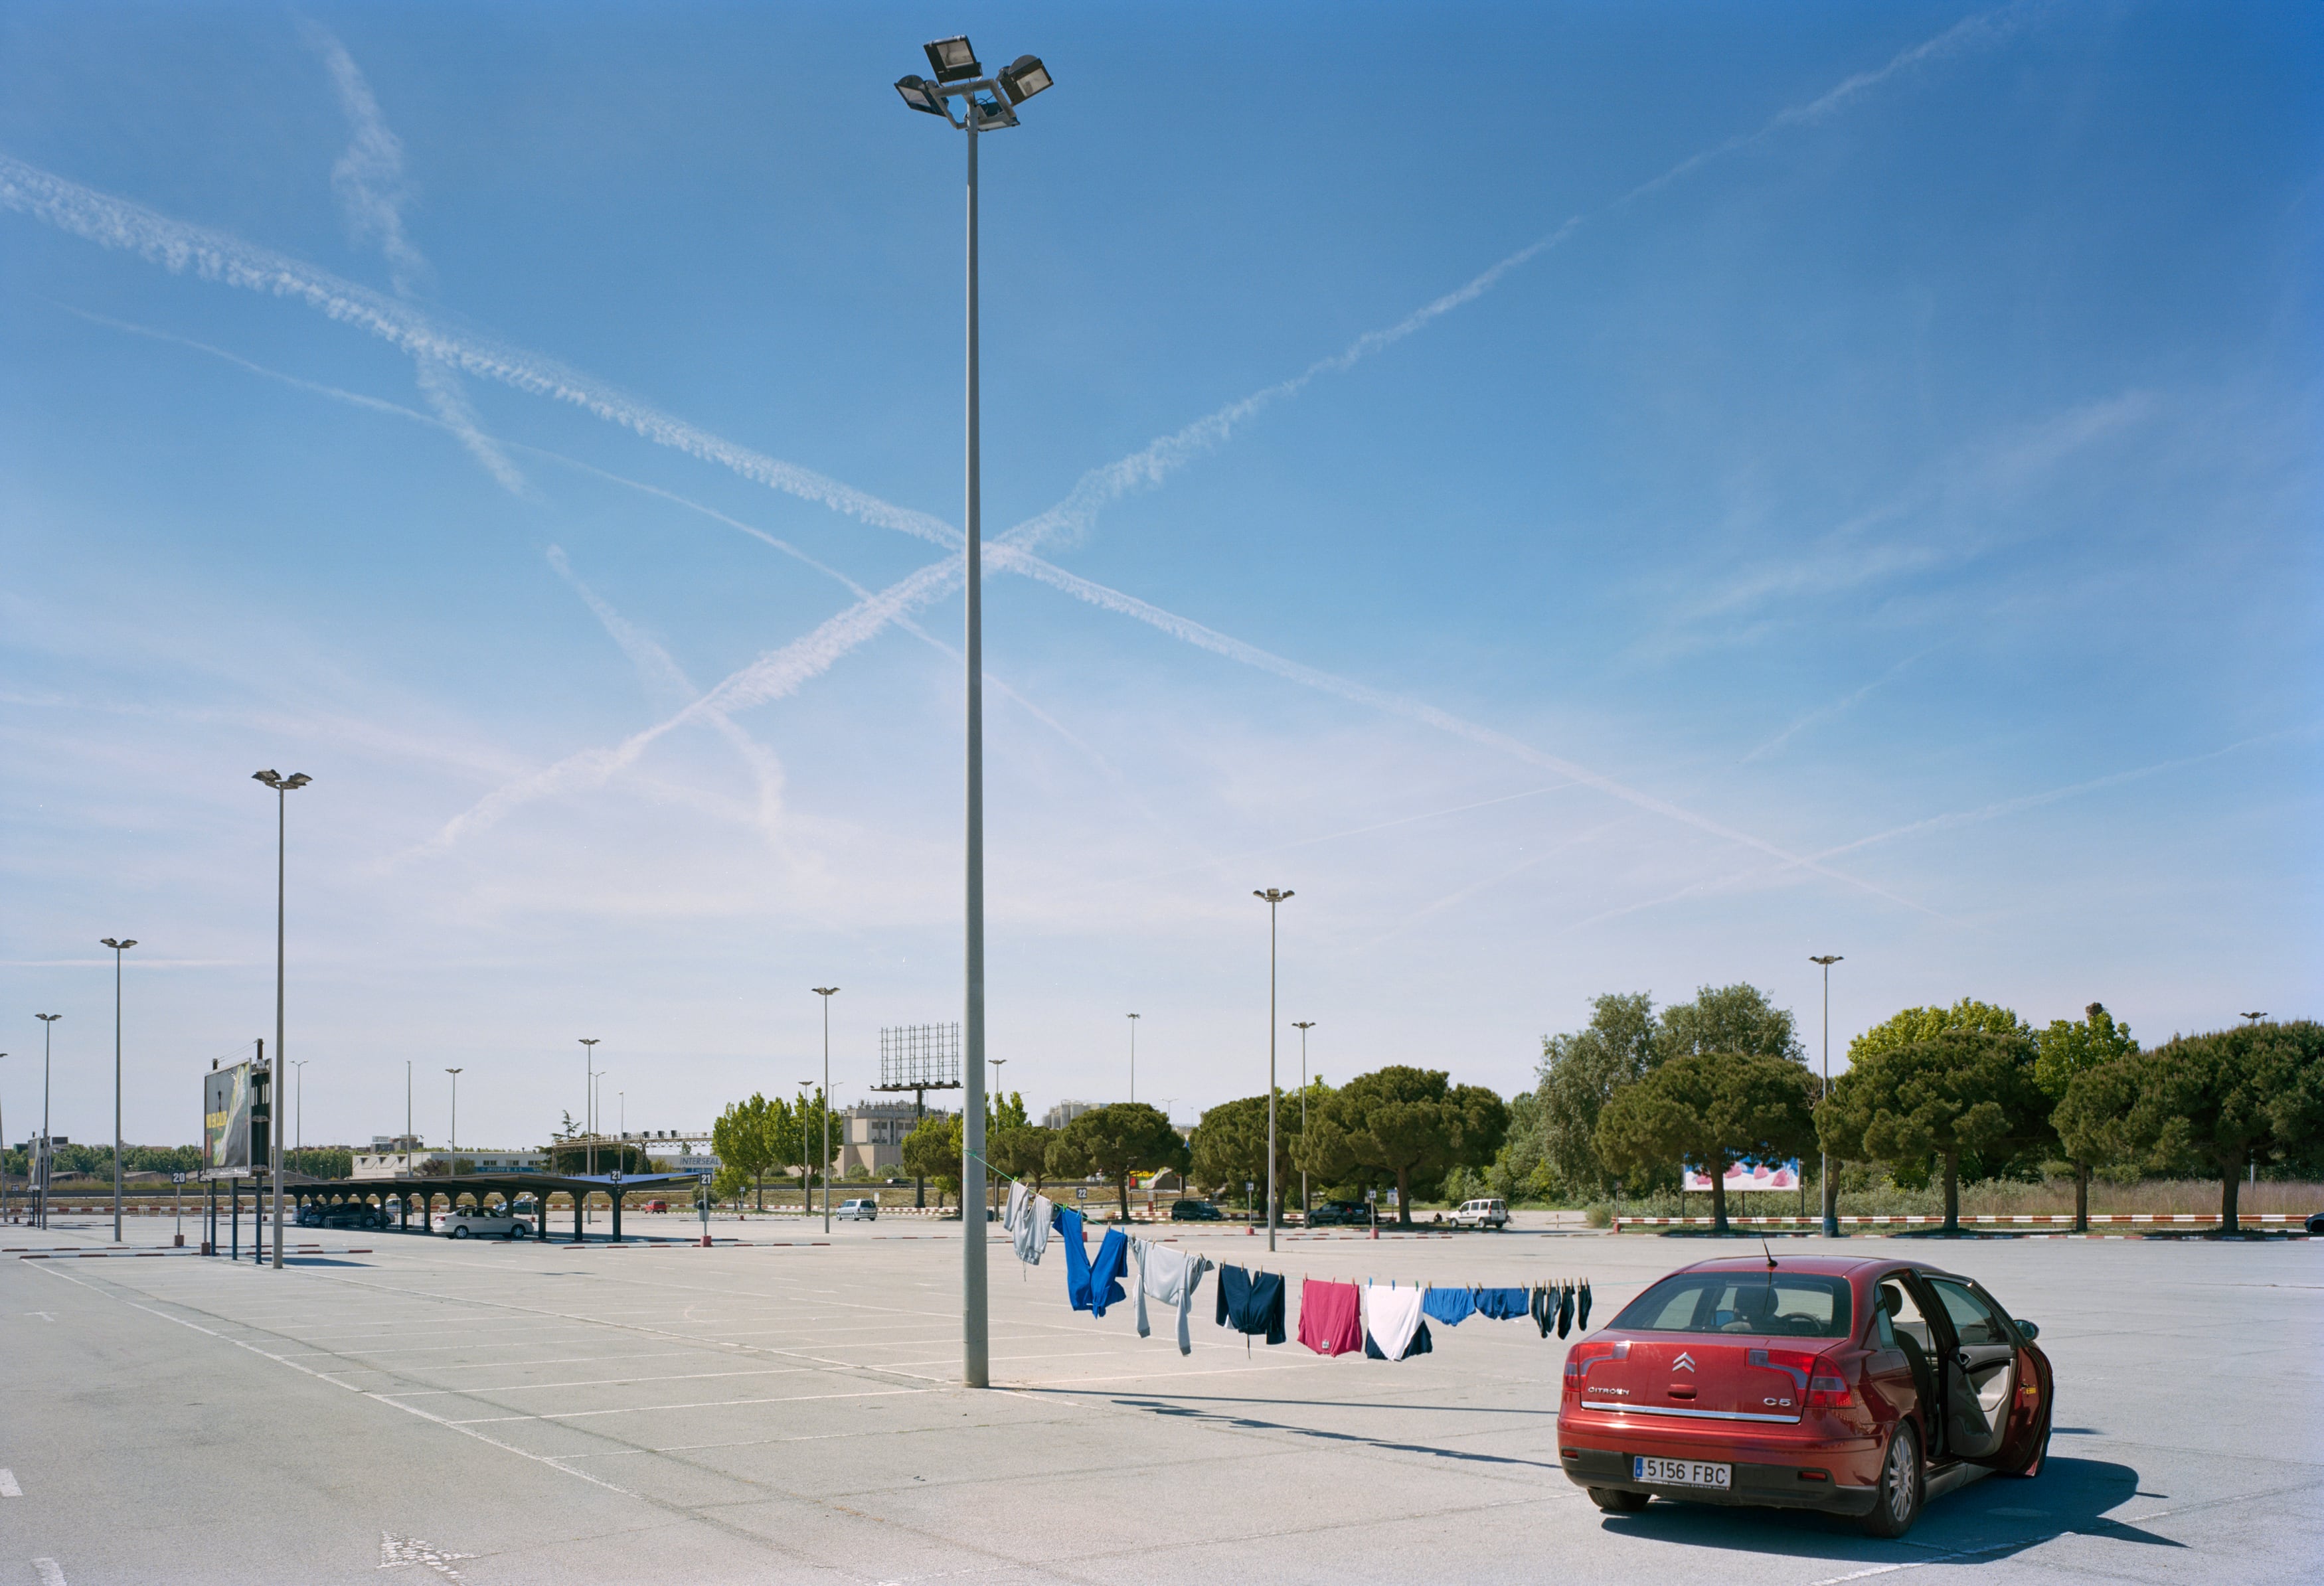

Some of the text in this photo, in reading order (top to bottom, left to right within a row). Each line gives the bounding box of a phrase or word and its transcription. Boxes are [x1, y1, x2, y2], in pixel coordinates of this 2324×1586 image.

[173, 1172, 185, 1182] 20
[612, 1170, 621, 1180] 21
[701, 1174, 711, 1184] 21
[1078, 1189, 1087, 1198] 22
[1369, 1190, 1376, 1199] 23
[1647, 1460, 1686, 1480] 5156
[1693, 1465, 1726, 1484] FBC
